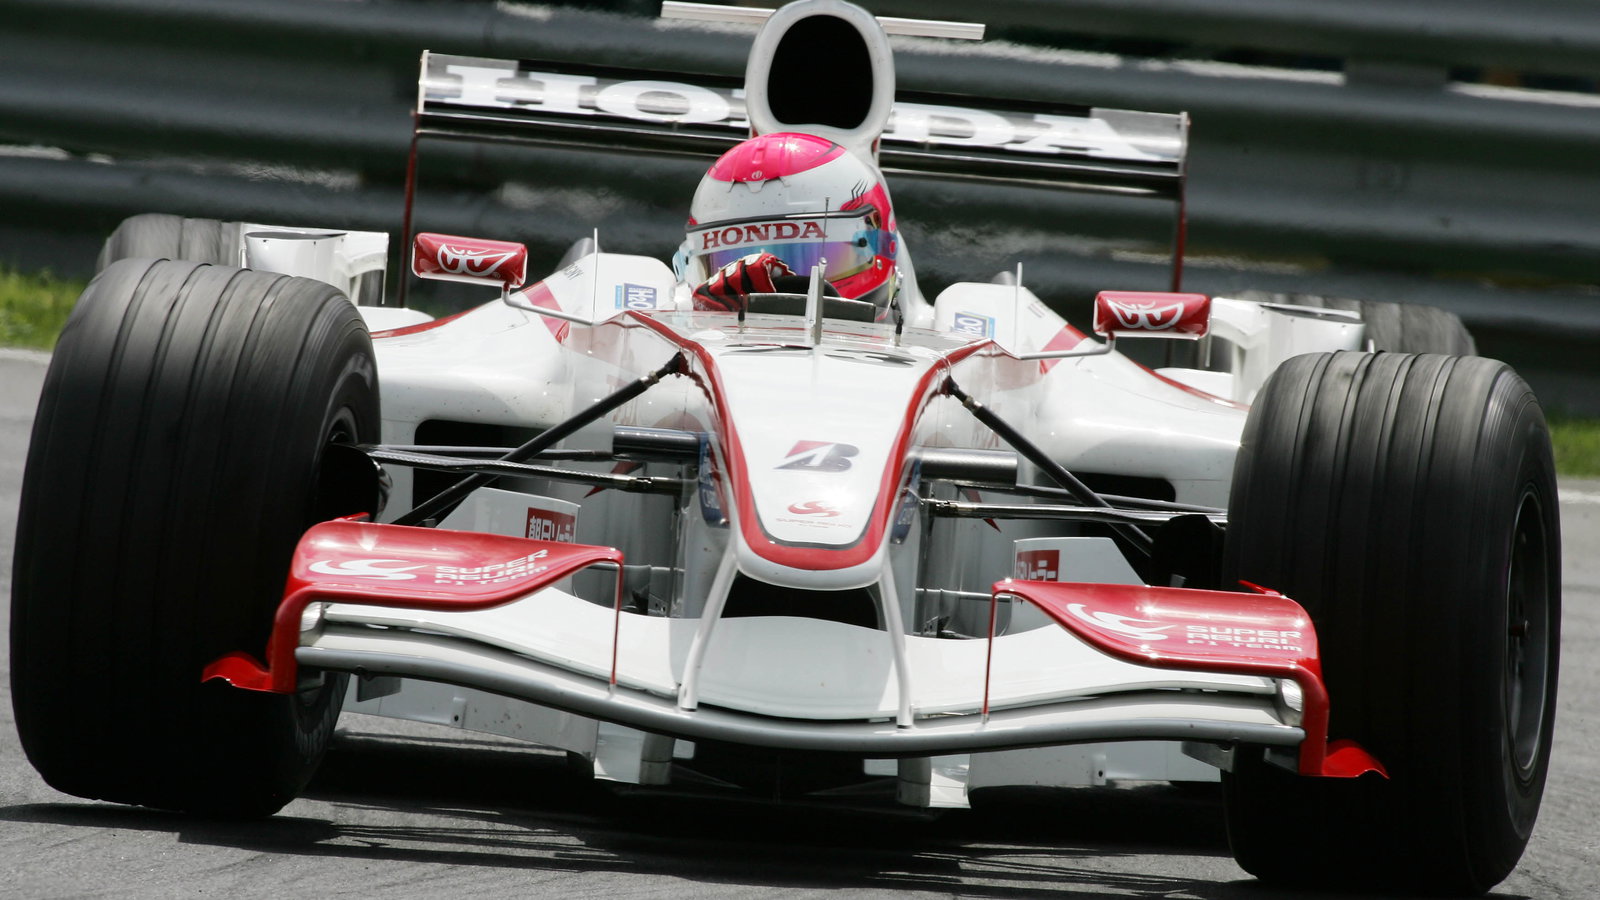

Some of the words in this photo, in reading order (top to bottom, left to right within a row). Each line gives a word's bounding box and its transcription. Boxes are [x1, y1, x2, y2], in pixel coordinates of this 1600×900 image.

[443, 64, 1163, 162] HODA
[702, 221, 829, 250] HONDA
[434, 549, 549, 574] SUPER
[434, 562, 535, 580] AGURI
[1186, 625, 1302, 638] SUPER
[1186, 632, 1289, 644] AGURI
